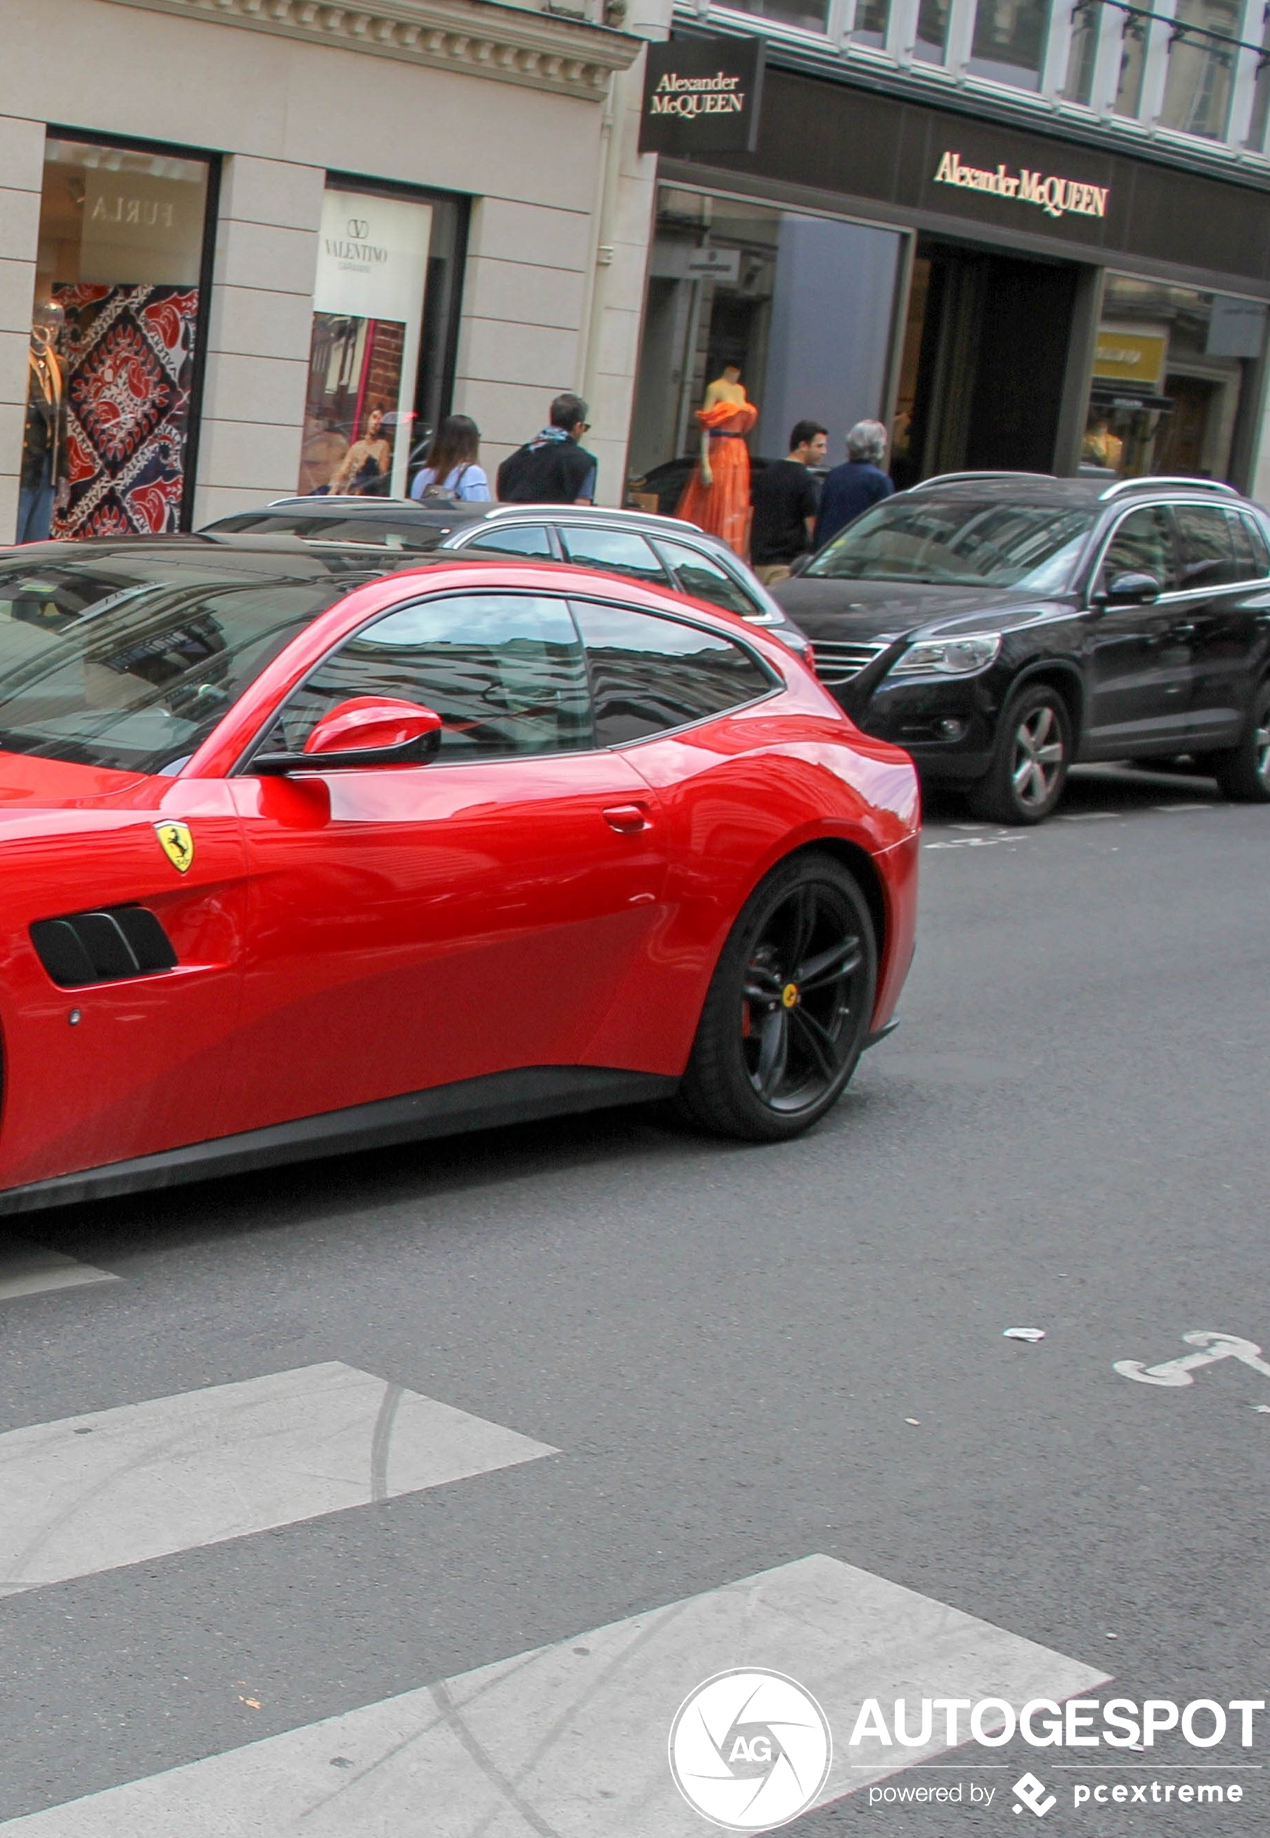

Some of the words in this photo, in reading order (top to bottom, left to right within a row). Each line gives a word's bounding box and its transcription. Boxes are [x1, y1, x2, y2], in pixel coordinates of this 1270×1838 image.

[655, 71, 740, 92] Alexander
[650, 93, 745, 119] McQUEEN
[933, 151, 1021, 198] Alexander
[1017, 169, 1110, 217] McQUEEN
[325, 239, 389, 263] VALENTINO
